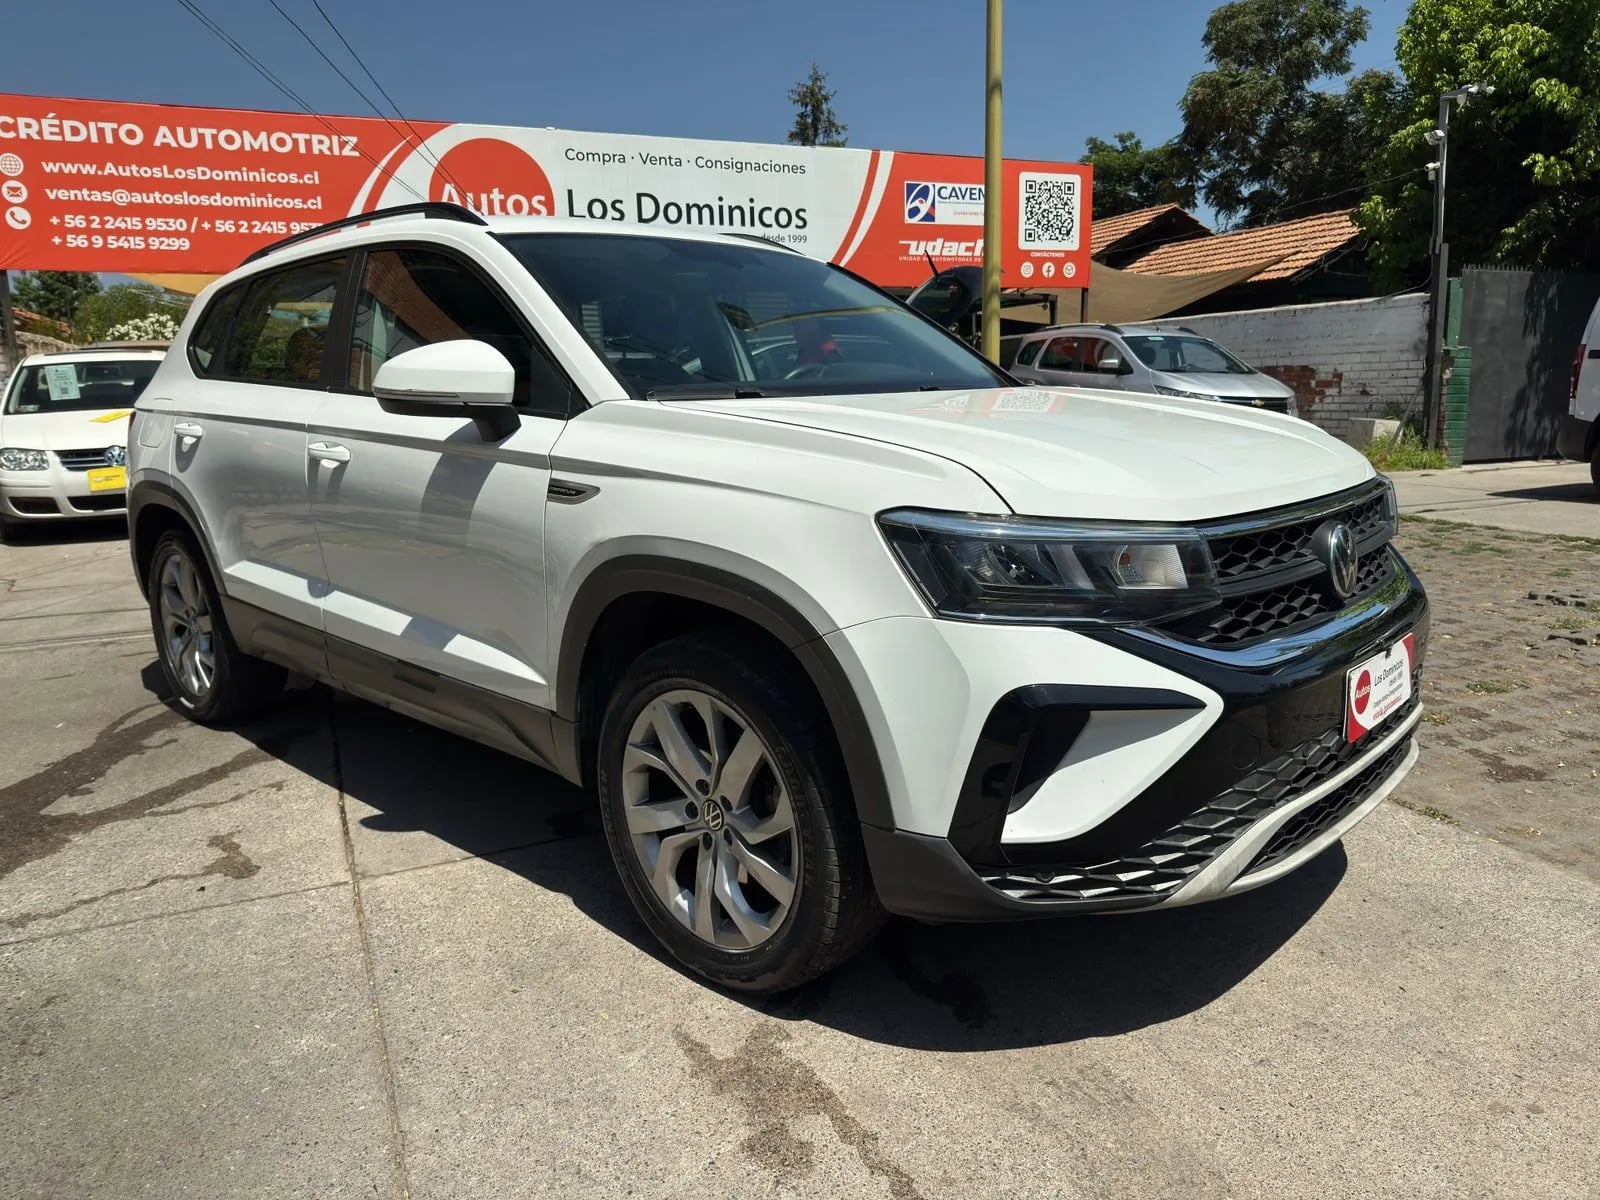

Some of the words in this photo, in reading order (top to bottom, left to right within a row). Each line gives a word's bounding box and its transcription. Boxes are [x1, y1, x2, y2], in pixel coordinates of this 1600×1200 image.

[0, 113, 144, 146] CRÉDITO
[153, 125, 361, 157] AUTOMOTRIZ
[41, 161, 320, 185] www.AutosLosDominicos.cl
[564, 148, 626, 165] Compra
[638, 152, 682, 168] Venta
[694, 156, 806, 175] Consignaciones
[45, 188, 323, 210] ventas@autoslosdominicos.cl
[440, 183, 547, 217] Autos
[566, 188, 626, 222] Los
[635, 192, 809, 230] Dominicos
[64, 214, 87, 228] 56
[89, 215, 102, 229] 2
[104, 216, 143, 230] 2415
[145, 217, 188, 232] 9530
[215, 219, 237, 233] 56
[238, 220, 250, 234] 2
[251, 220, 289, 234] 2415
[66, 234, 89, 248] 56
[91, 235, 104, 248] 9
[107, 235, 146, 249] 5415
[148, 237, 191, 251] 9299
[788, 234, 808, 244] 1999
[1355, 684, 1371, 699] Autos
